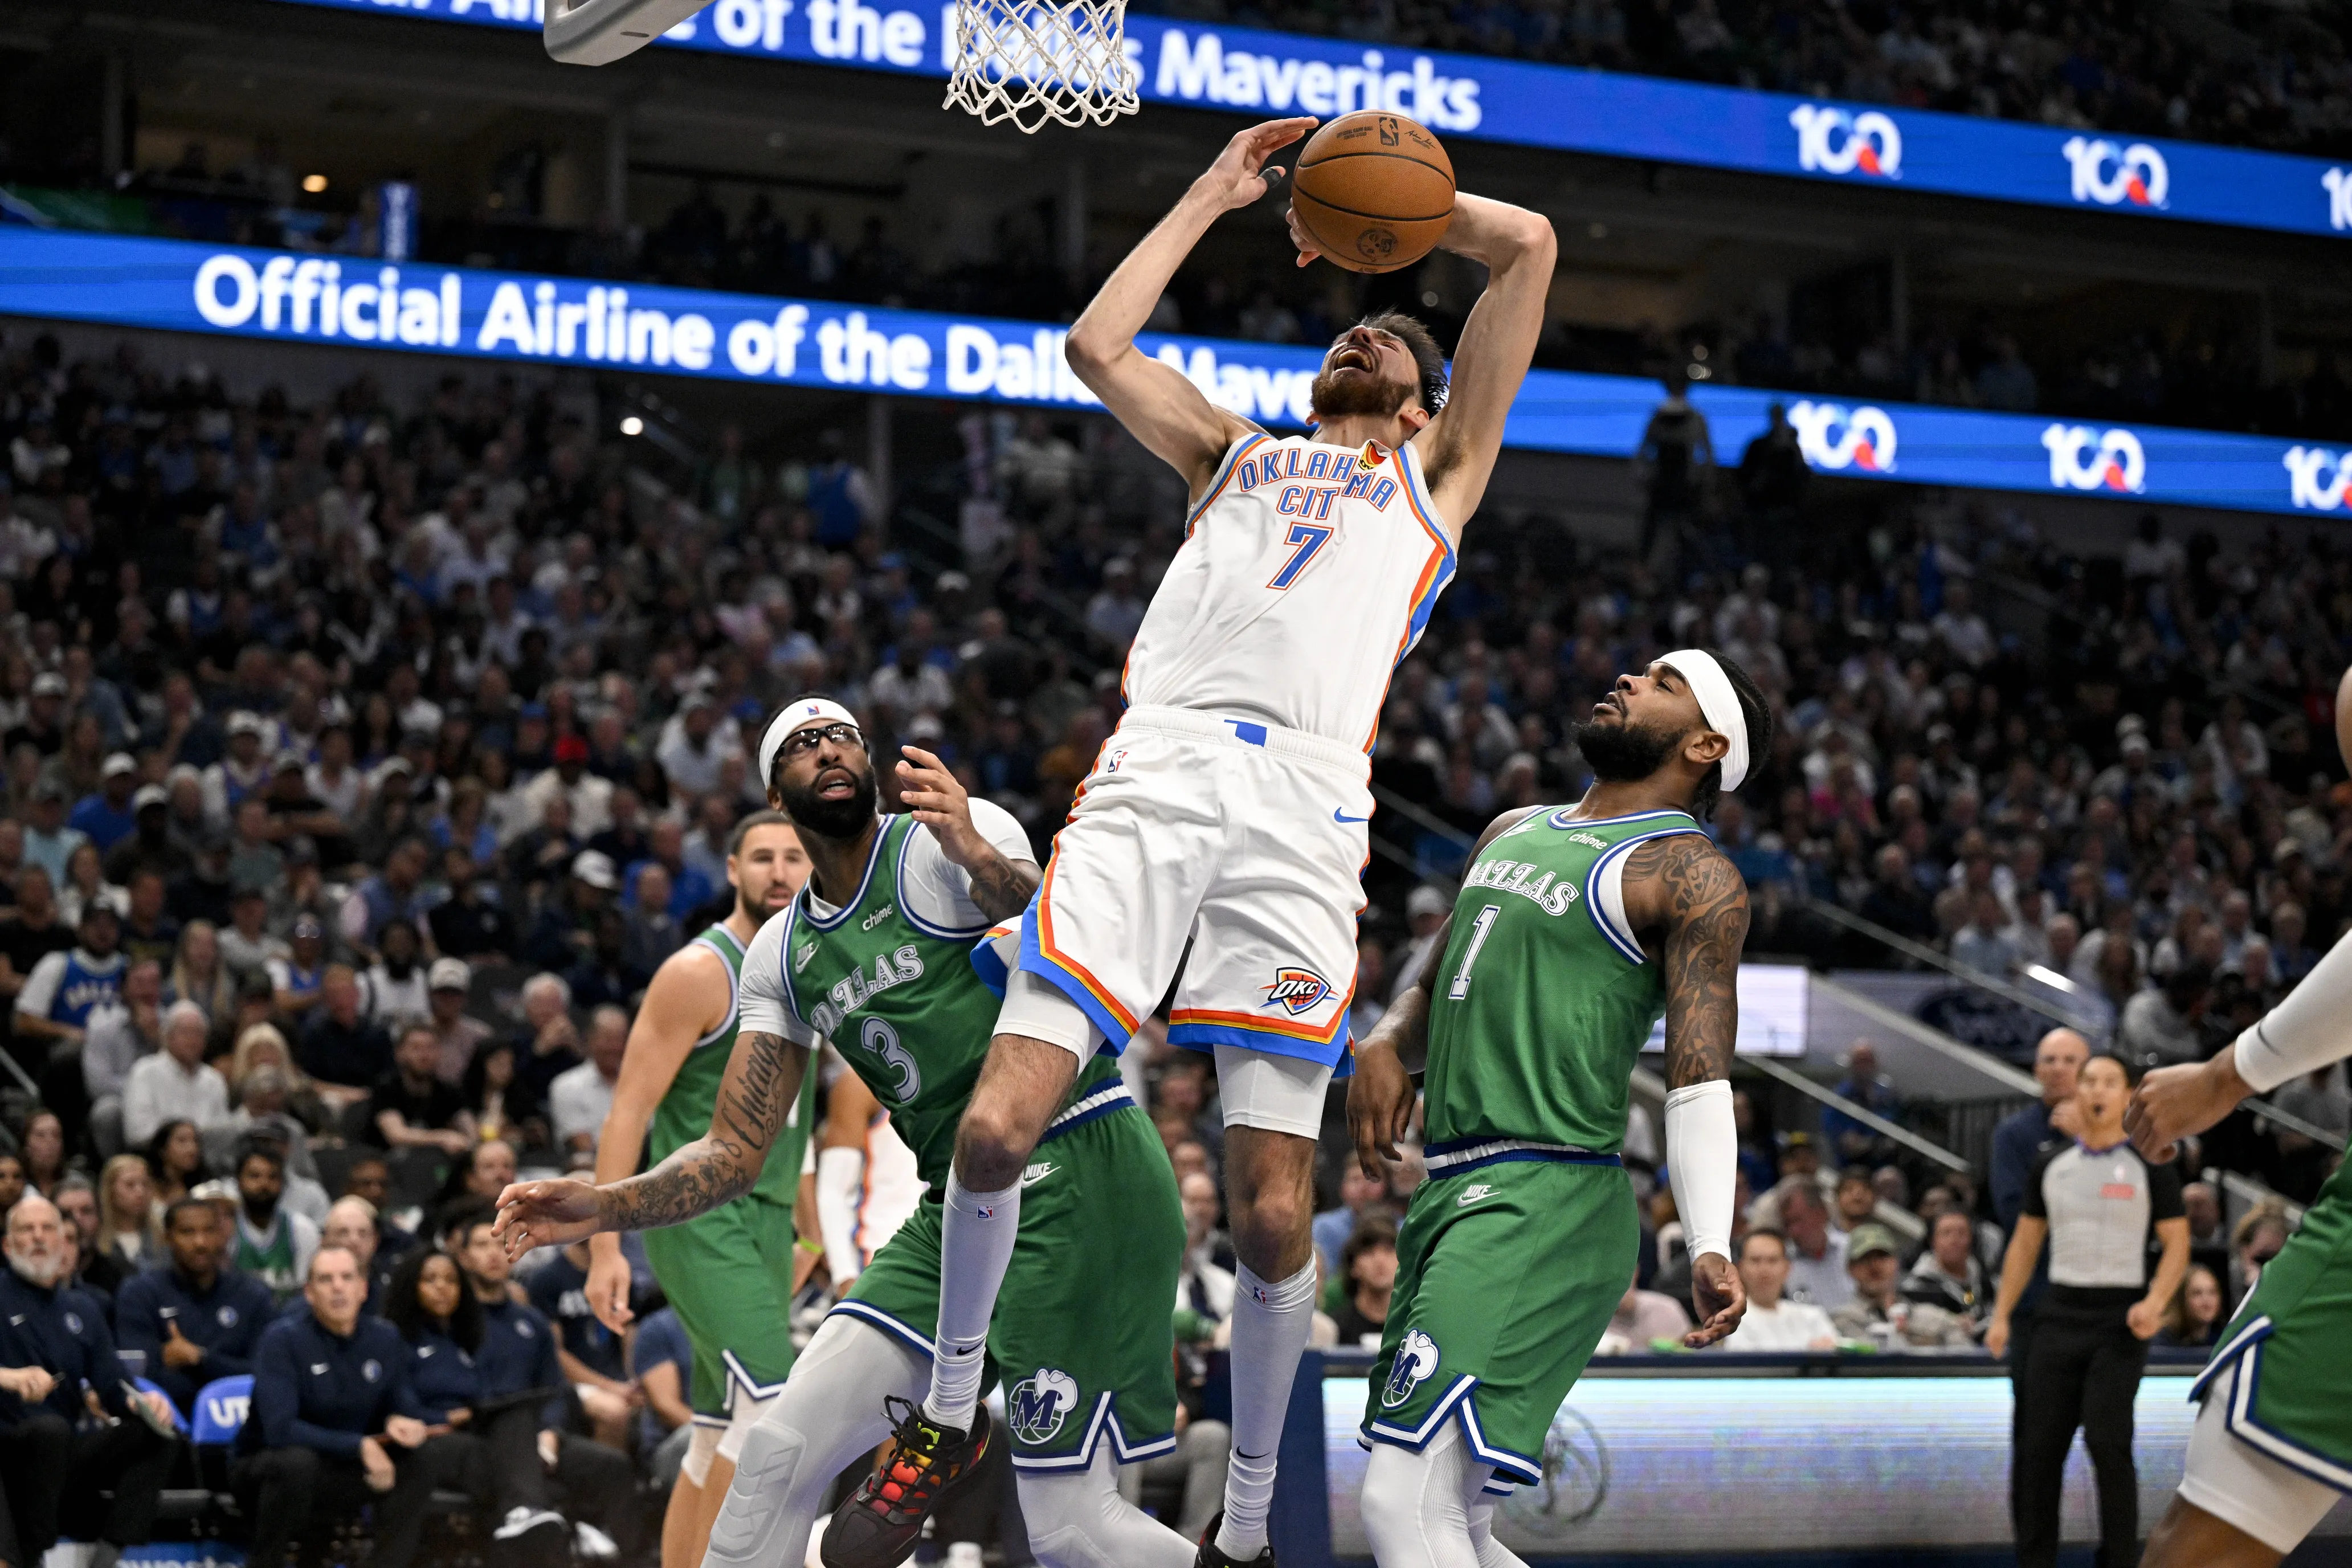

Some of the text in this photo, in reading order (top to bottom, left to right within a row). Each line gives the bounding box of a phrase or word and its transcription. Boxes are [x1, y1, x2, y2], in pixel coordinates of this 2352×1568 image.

[806, 0, 926, 67] the
[1155, 28, 1481, 132] Mavericks
[194, 254, 461, 347] Official
[476, 280, 716, 370] Airline
[727, 304, 809, 378] of
[815, 311, 931, 391] the
[945, 324, 1103, 404] Dall
[1238, 448, 1398, 513] OKLAHMA
[1276, 485, 1340, 520] CIT
[1266, 522, 1334, 590] 7
[1569, 832, 1607, 850] chime
[863, 904, 893, 931] chime
[1448, 904, 1501, 1001] 1
[1270, 980, 1319, 999] OKC
[861, 1016, 920, 1104] 3
[1024, 1162, 1051, 1179] NIKE
[1463, 1185, 1492, 1197] NIKE
